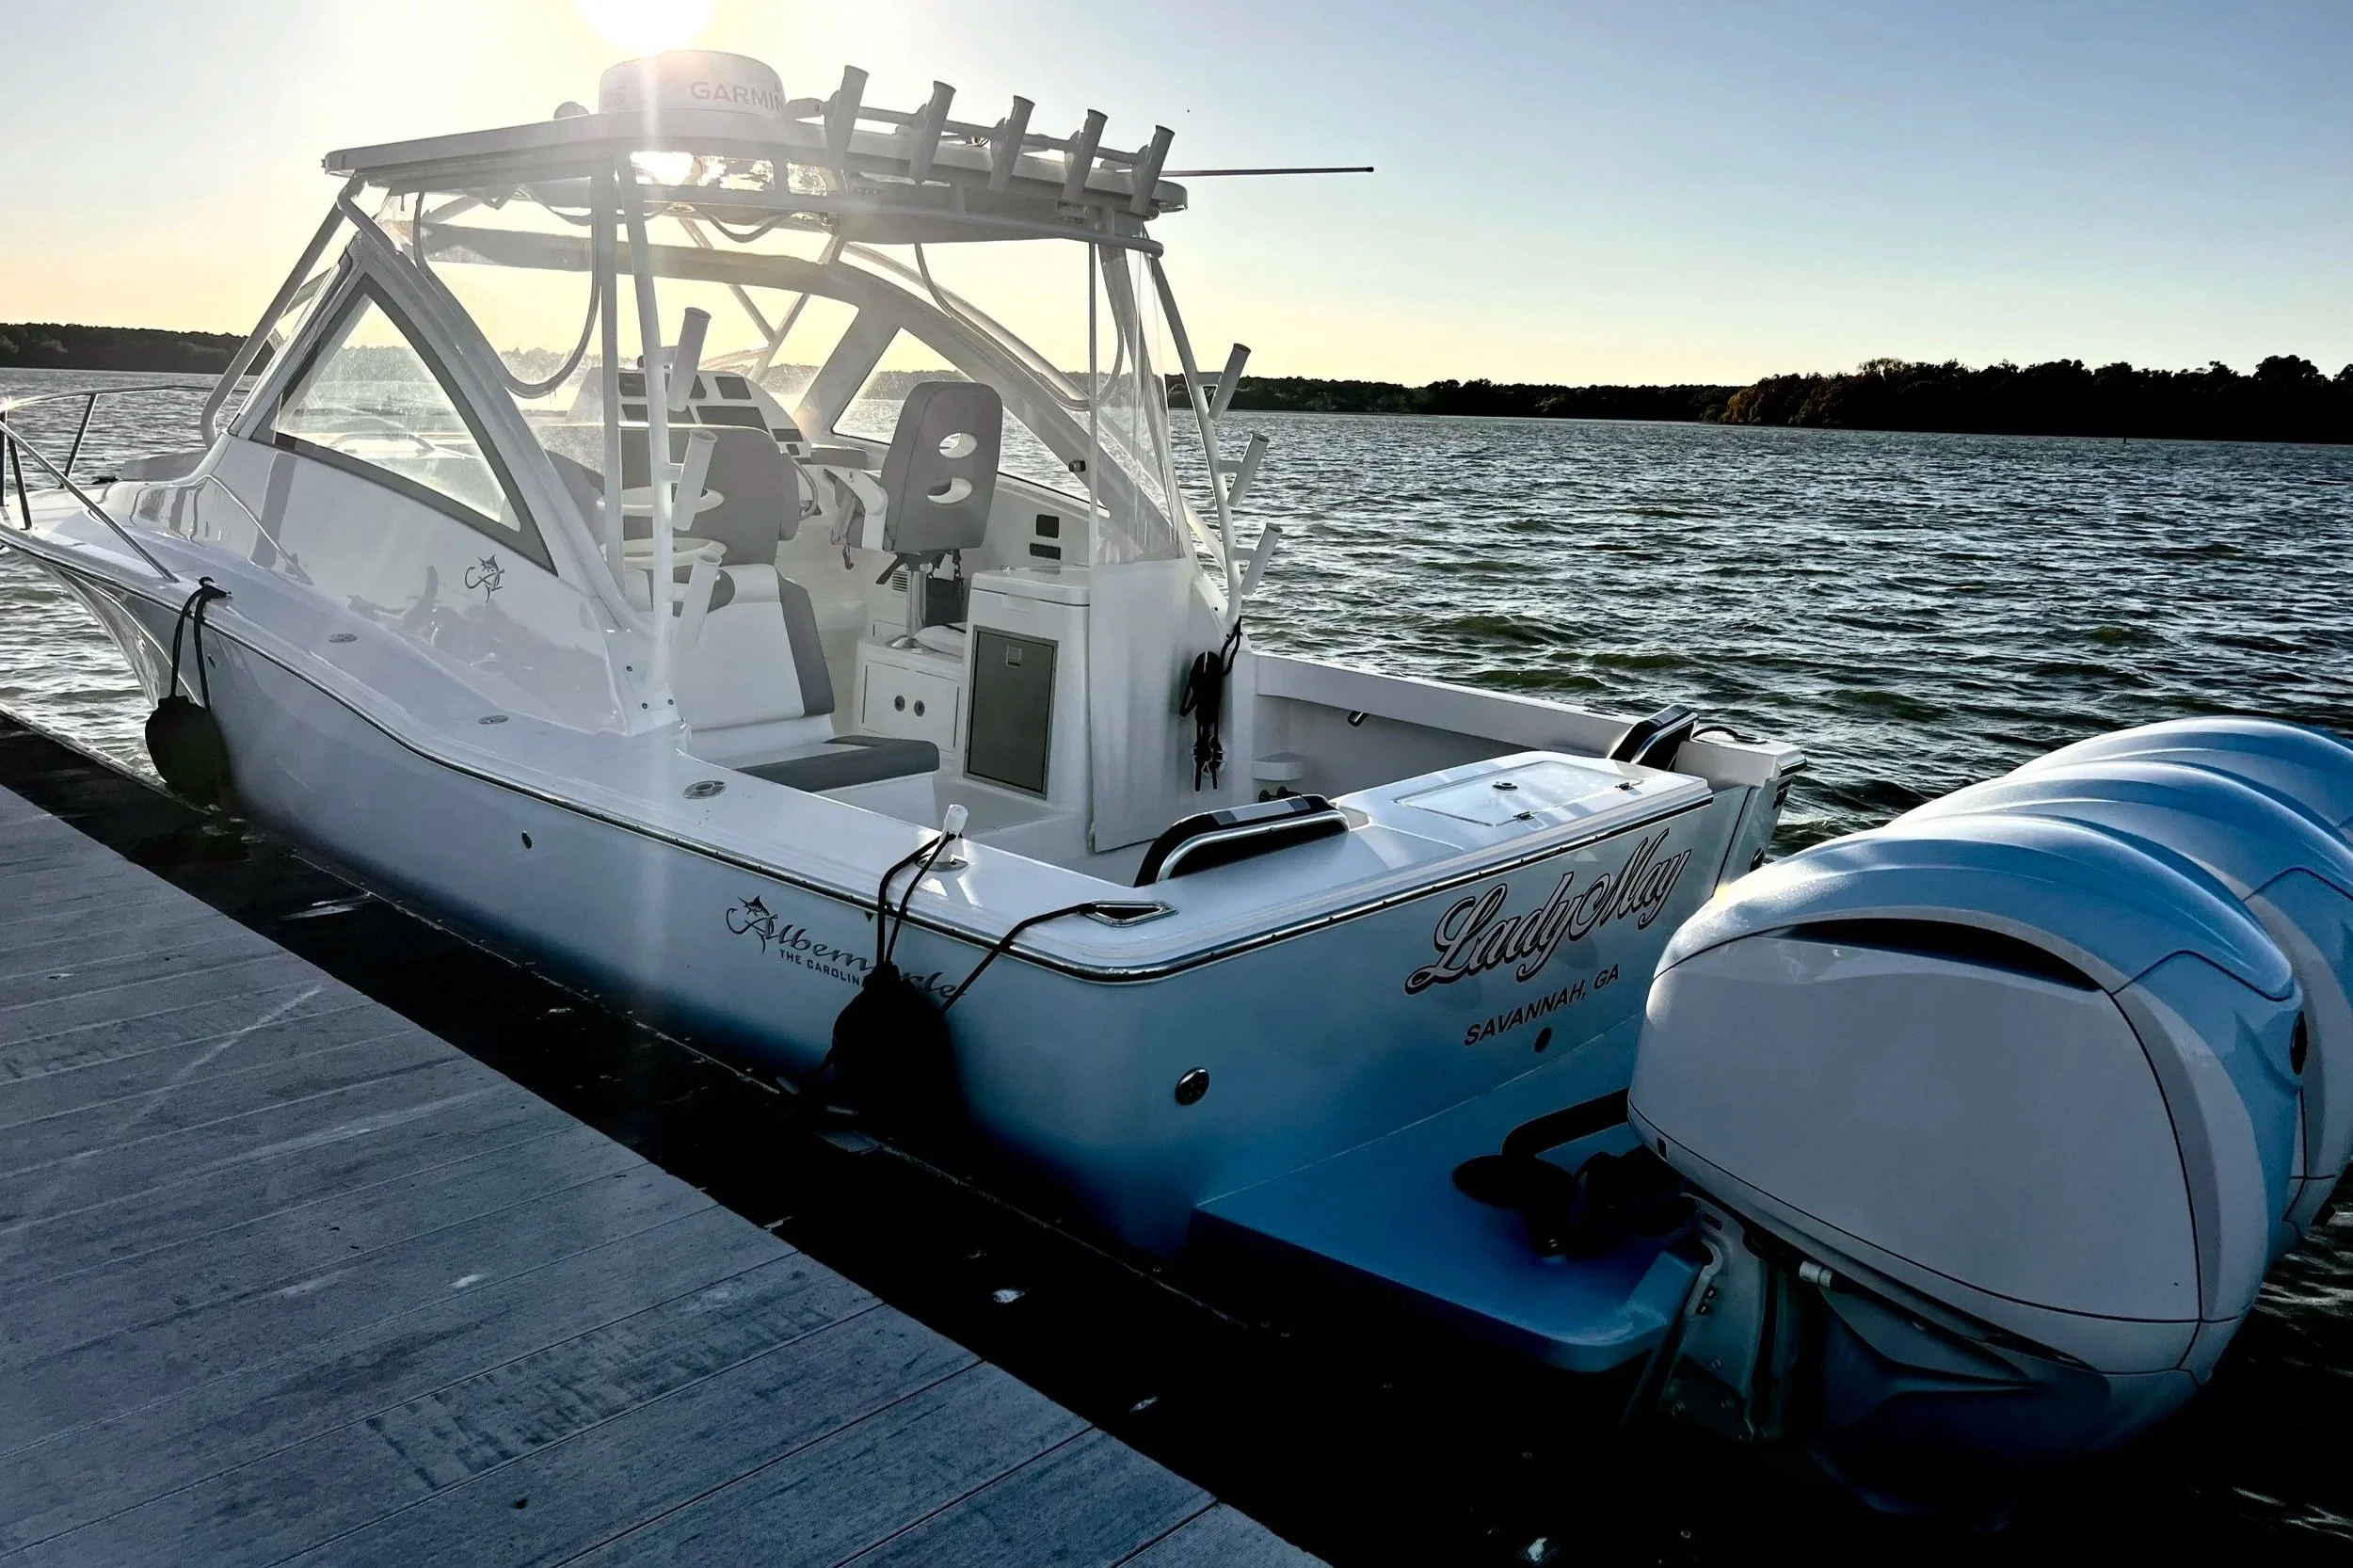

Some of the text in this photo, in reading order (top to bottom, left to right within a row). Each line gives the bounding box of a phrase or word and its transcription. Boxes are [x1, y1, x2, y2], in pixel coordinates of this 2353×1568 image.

[690, 81, 784, 112] GARMIN
[779, 949, 863, 987] THE CAROLIN
[1464, 964, 1620, 1047] SAVANNAH, GA
